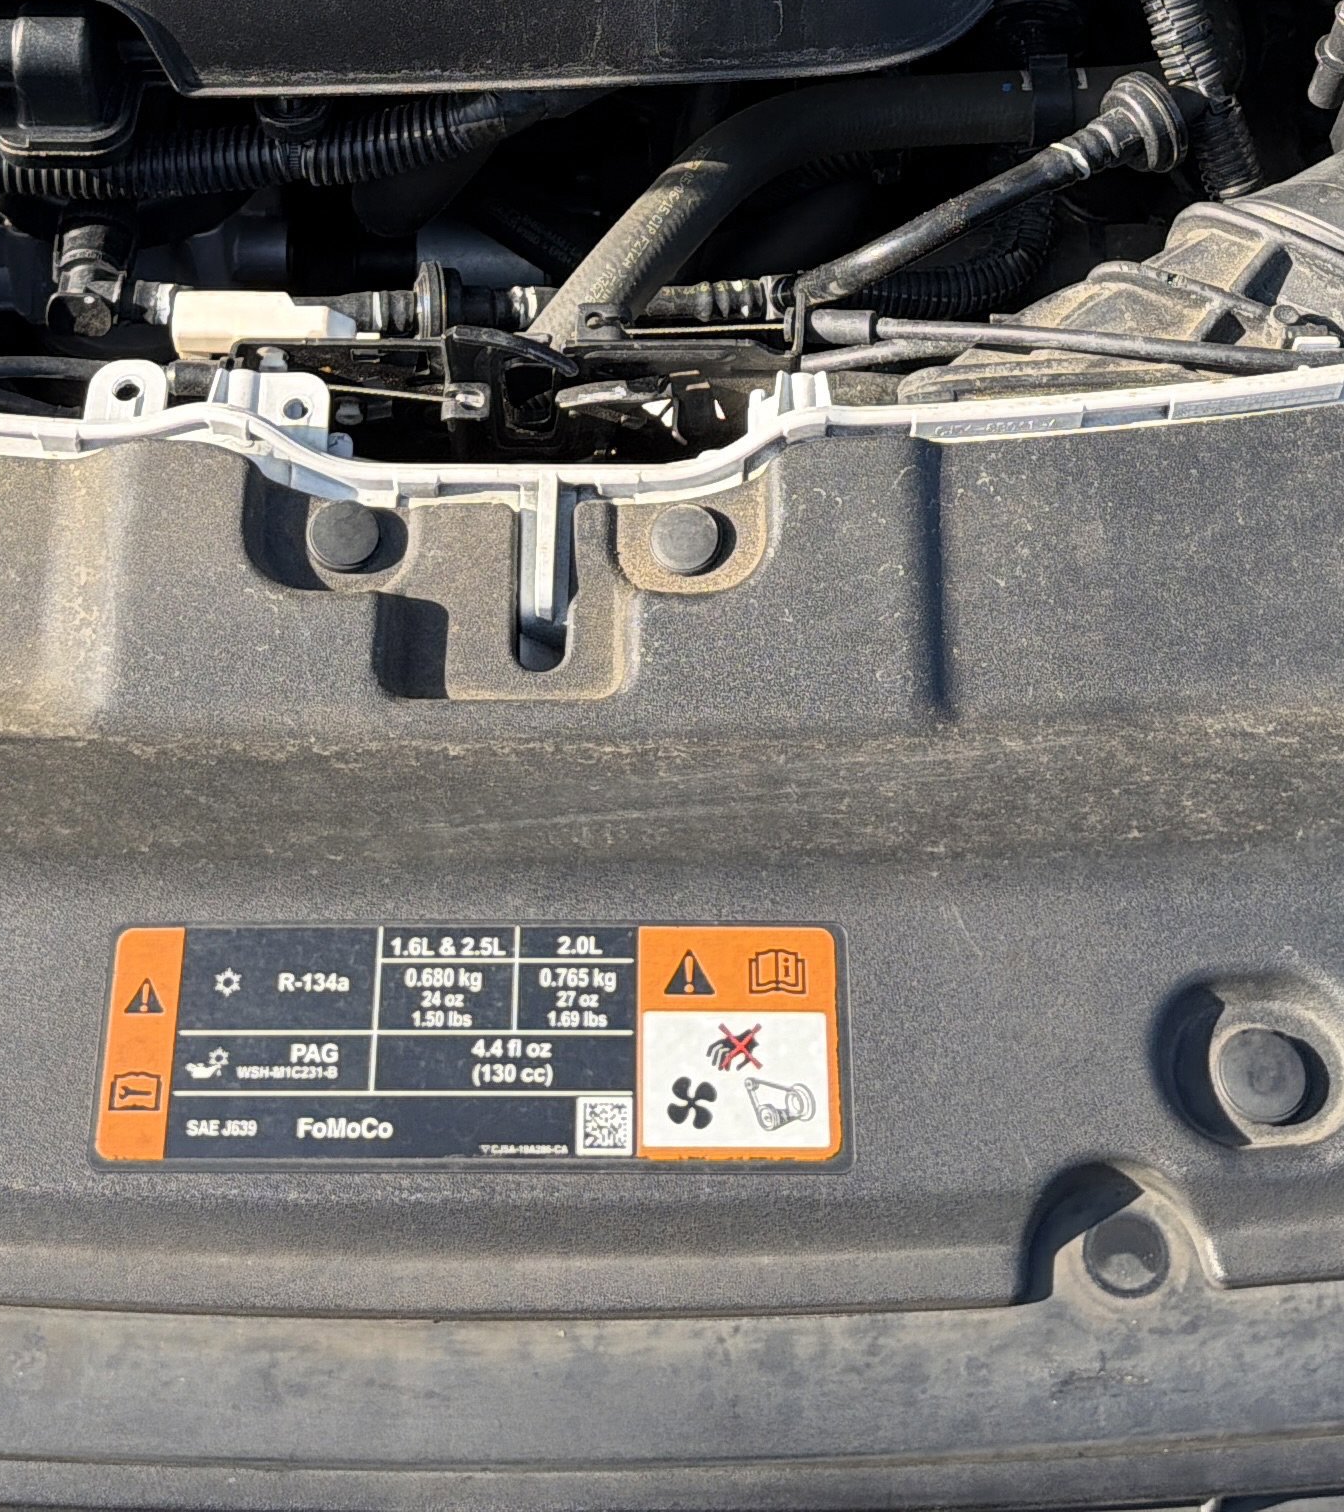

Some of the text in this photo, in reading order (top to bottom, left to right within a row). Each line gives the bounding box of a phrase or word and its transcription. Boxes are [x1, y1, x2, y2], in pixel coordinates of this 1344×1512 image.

[391, 936, 603, 959] 1.6L & 2.5L 2.0L
[278, 973, 349, 992] R-134a
[404, 968, 482, 992] 0.680 kg
[539, 968, 616, 992] 0.765 kg
[422, 992, 464, 1007] 24 oz
[557, 992, 599, 1007] 27 oz
[412, 1010, 472, 1027] 1.50 lbs
[547, 1011, 608, 1027] 1.69 lbs
[290, 1043, 339, 1063] PAG
[471, 1039, 552, 1058] 4.4 fl oz
[472, 1063, 553, 1087] (130 cc)
[186, 1120, 257, 1136] SAE J639
[297, 1117, 393, 1139] FoMoCo
